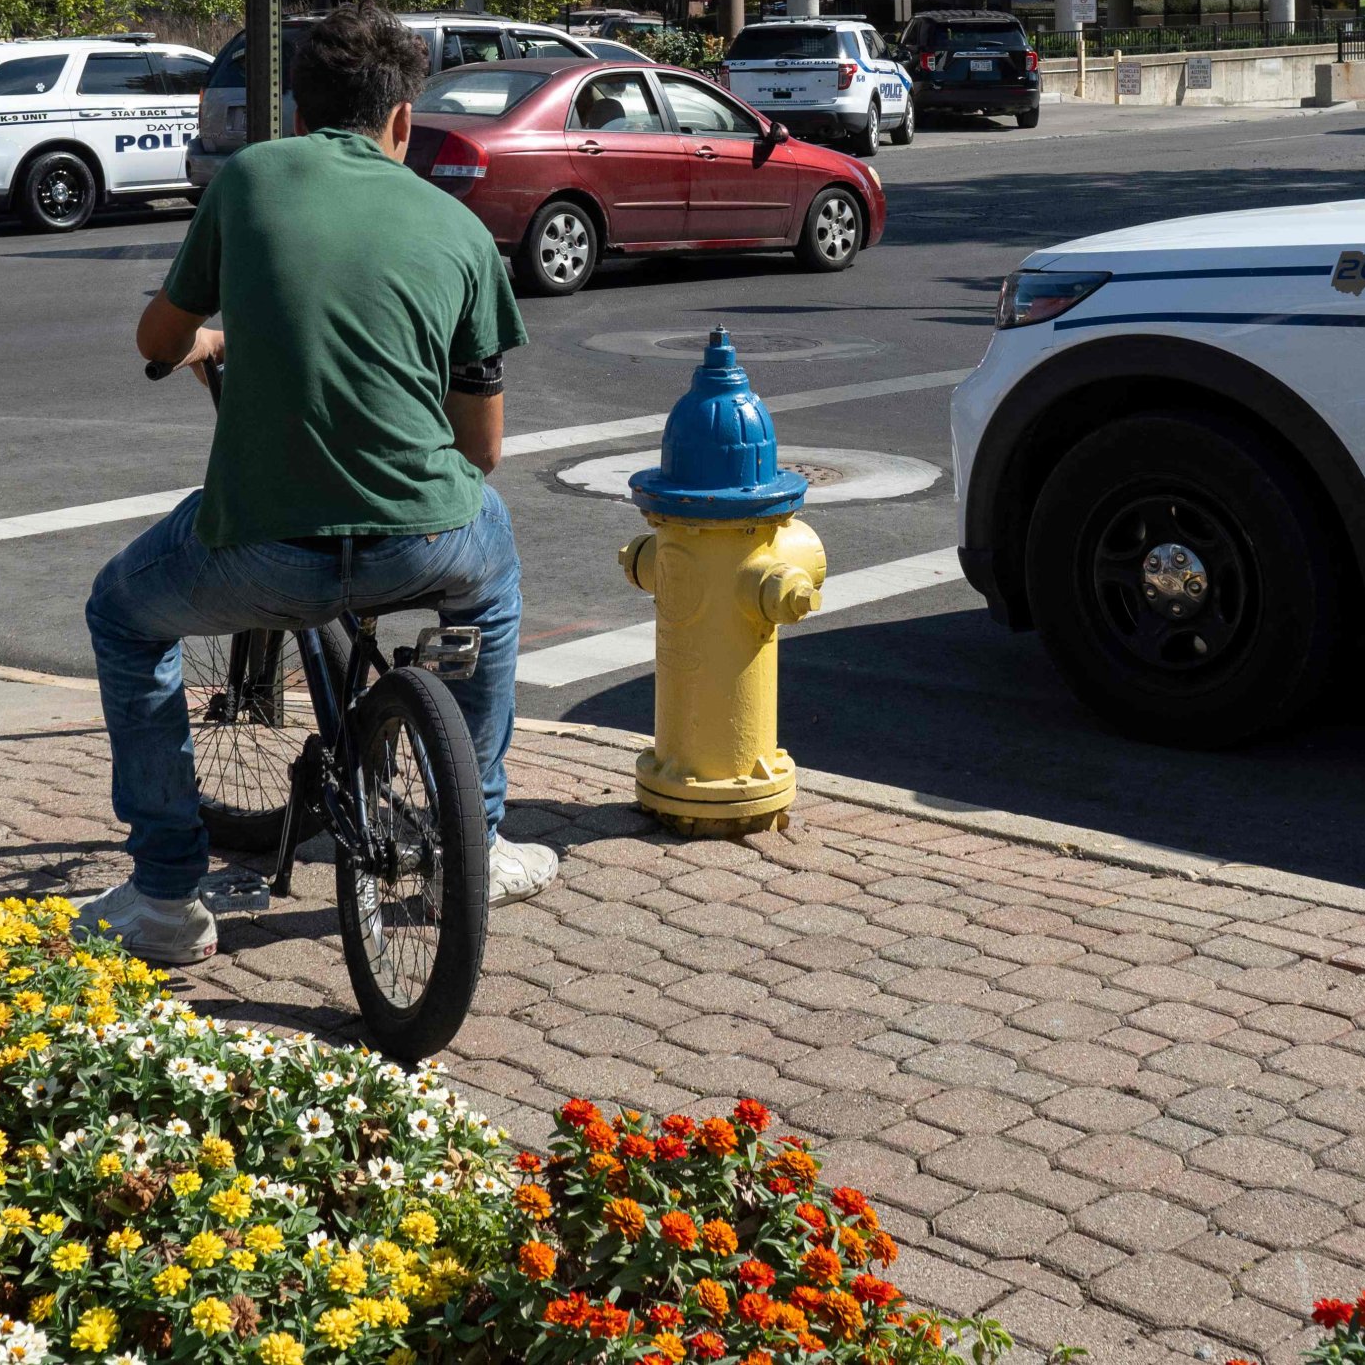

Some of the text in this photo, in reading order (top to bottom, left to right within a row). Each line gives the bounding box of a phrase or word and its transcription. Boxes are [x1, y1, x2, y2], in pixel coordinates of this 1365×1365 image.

[880, 83, 903, 99] POLICE
[0, 113, 48, 123] K-9 UNIT
[140, 109, 168, 117] BACK
[115, 133, 191, 153] POLI
